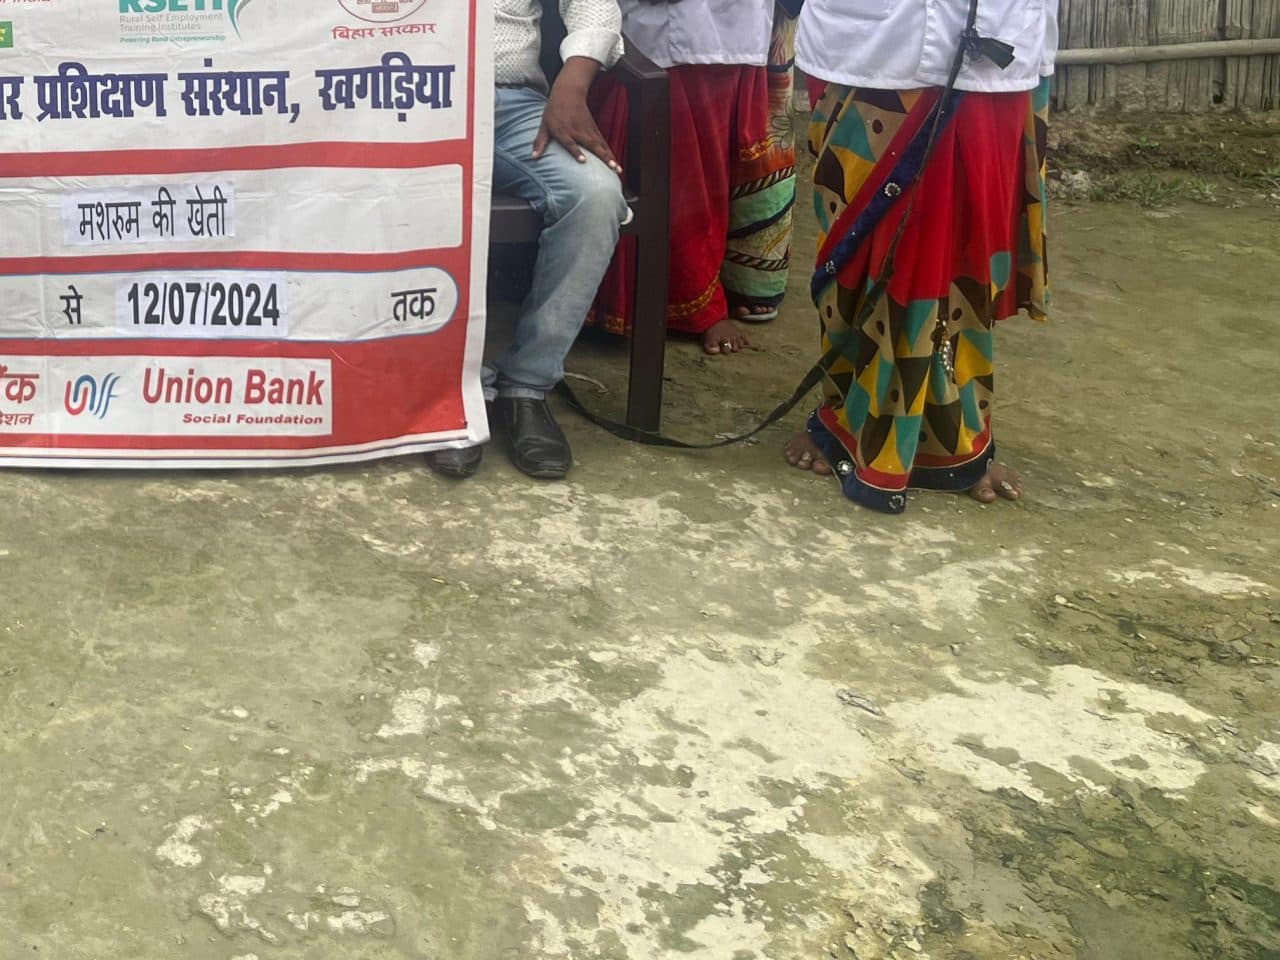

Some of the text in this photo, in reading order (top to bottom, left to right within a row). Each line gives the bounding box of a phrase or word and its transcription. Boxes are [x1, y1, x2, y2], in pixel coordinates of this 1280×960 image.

[120, 15, 143, 23] Rural
[146, 14, 163, 22] Self
[120, 22, 201, 32] Training Institutes
[331, 23, 436, 39] बिहार सरकार
[34, 62, 168, 122] प्रशिक्षण
[178, 58, 300, 123] संस्थान,
[316, 52, 455, 122] खगड़िया
[151, 186, 176, 236] की
[186, 185, 227, 236] खेती
[60, 284, 83, 324] से
[127, 282, 280, 326] 12/07/2024
[391, 287, 437, 321] तक
[143, 367, 325, 405] Union Bank
[182, 413, 323, 425] Social Foundation
